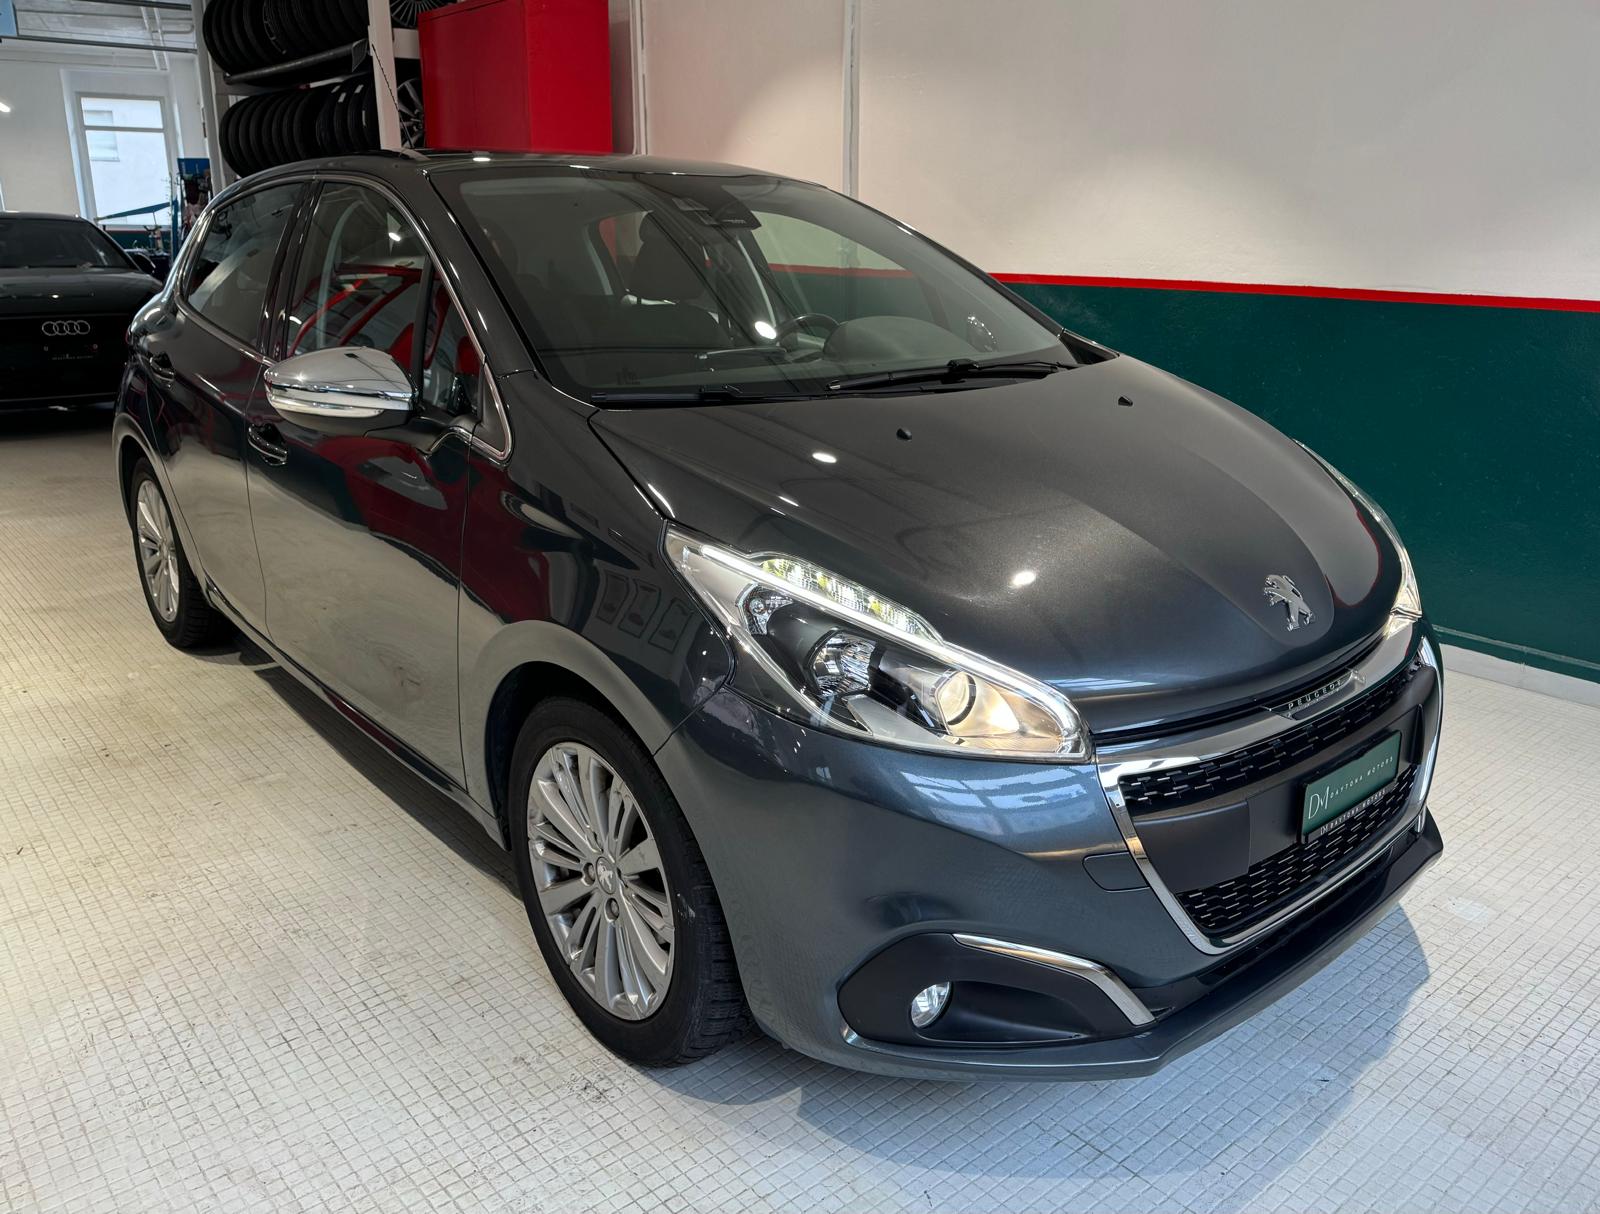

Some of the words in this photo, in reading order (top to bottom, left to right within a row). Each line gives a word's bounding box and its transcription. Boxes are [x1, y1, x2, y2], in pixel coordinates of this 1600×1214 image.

[1288, 679, 1341, 710] PEUGEOT
[1330, 775, 1363, 799] DAYTONA
[1367, 756, 1393, 776] MOTORS
[1330, 807, 1359, 829] DAYTONA
[1362, 788, 1386, 808] MOTORS
